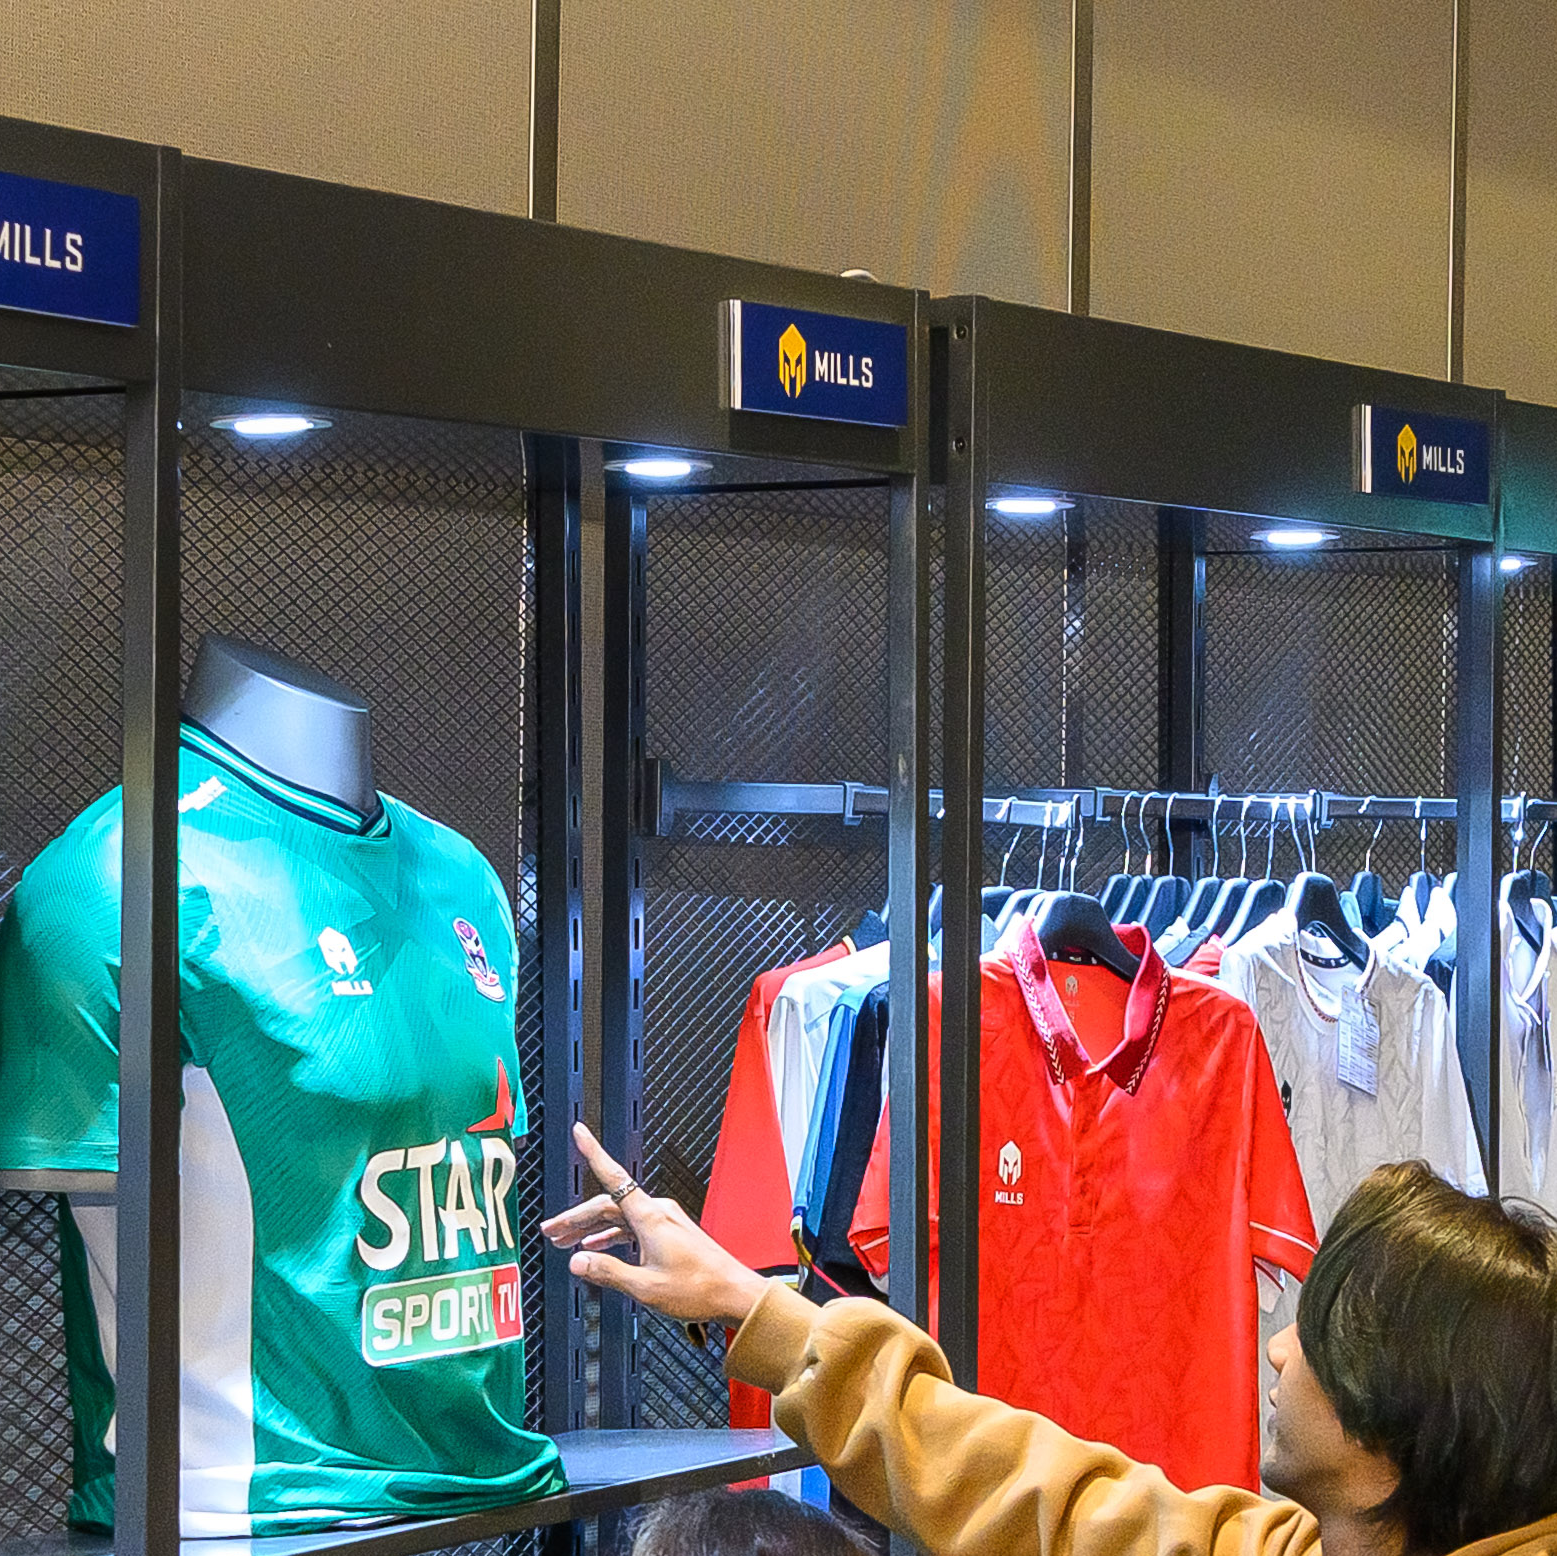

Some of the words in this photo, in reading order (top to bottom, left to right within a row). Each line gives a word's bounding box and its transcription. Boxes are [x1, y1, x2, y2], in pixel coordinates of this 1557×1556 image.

[814, 350, 873, 388] MILLS
[1422, 444, 1464, 474] MILLS
[356, 1136, 516, 1271] STAR
[994, 1190, 1023, 1205] MILLS
[372, 1283, 491, 1351] SPORT
[497, 1282, 519, 1324] TV
